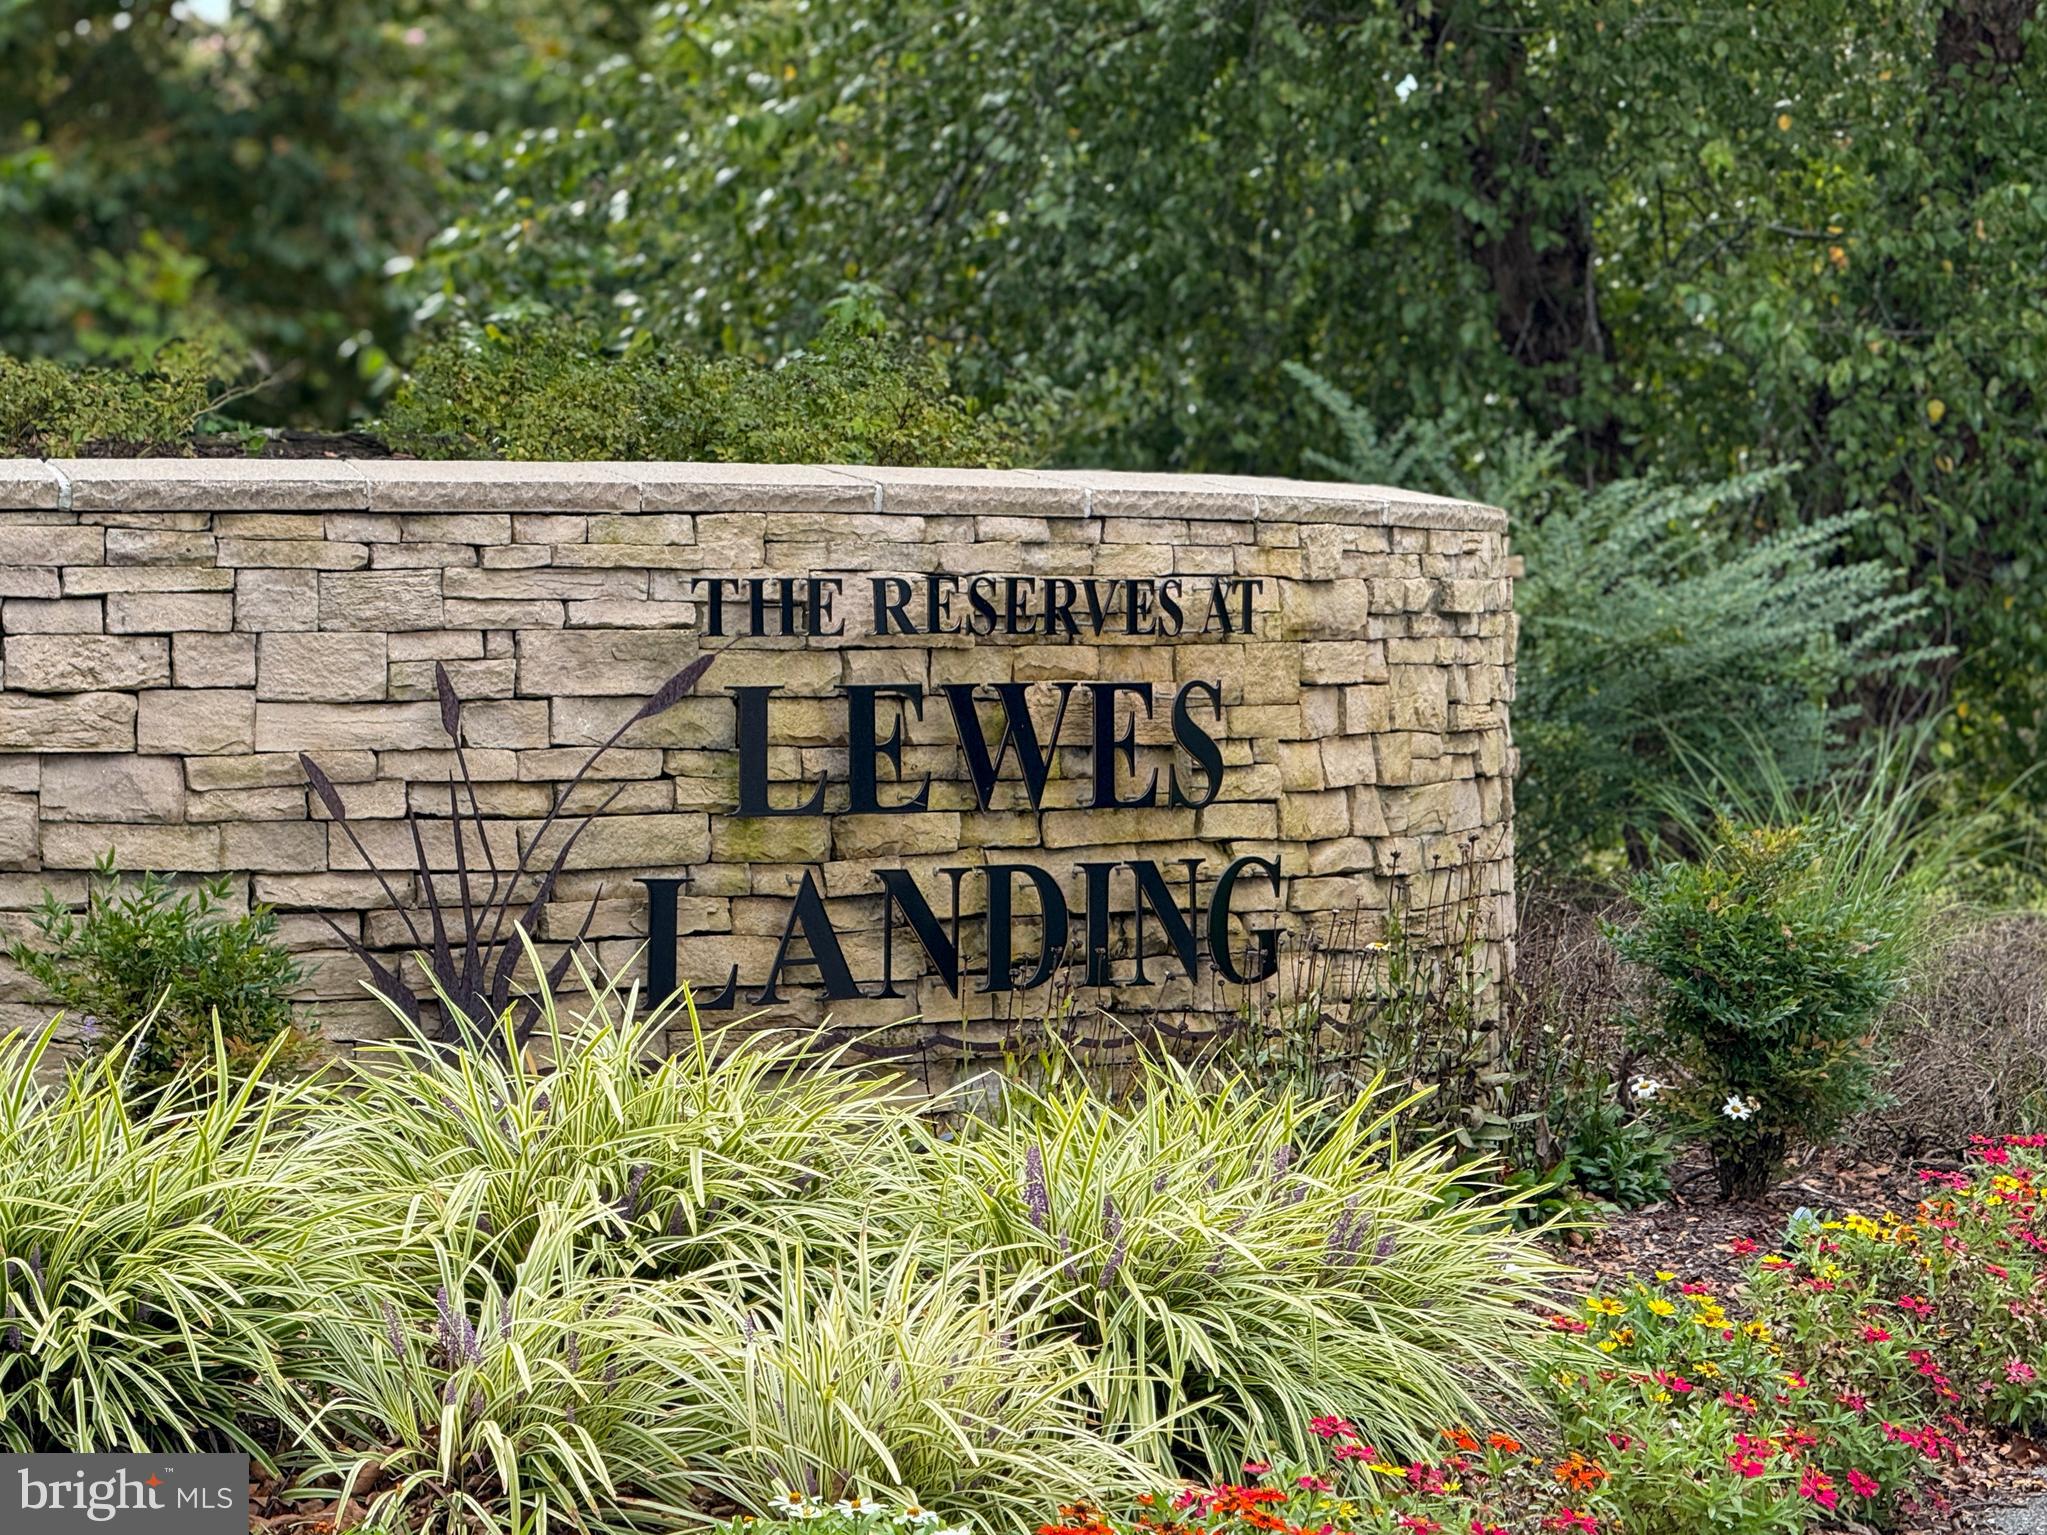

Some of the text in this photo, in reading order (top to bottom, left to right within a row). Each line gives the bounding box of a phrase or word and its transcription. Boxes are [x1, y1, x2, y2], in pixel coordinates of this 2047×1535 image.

[691, 576, 1264, 637] THE RESERVES AT
[725, 679, 1225, 818] LEWES
[632, 854, 1284, 1011] LANDING
